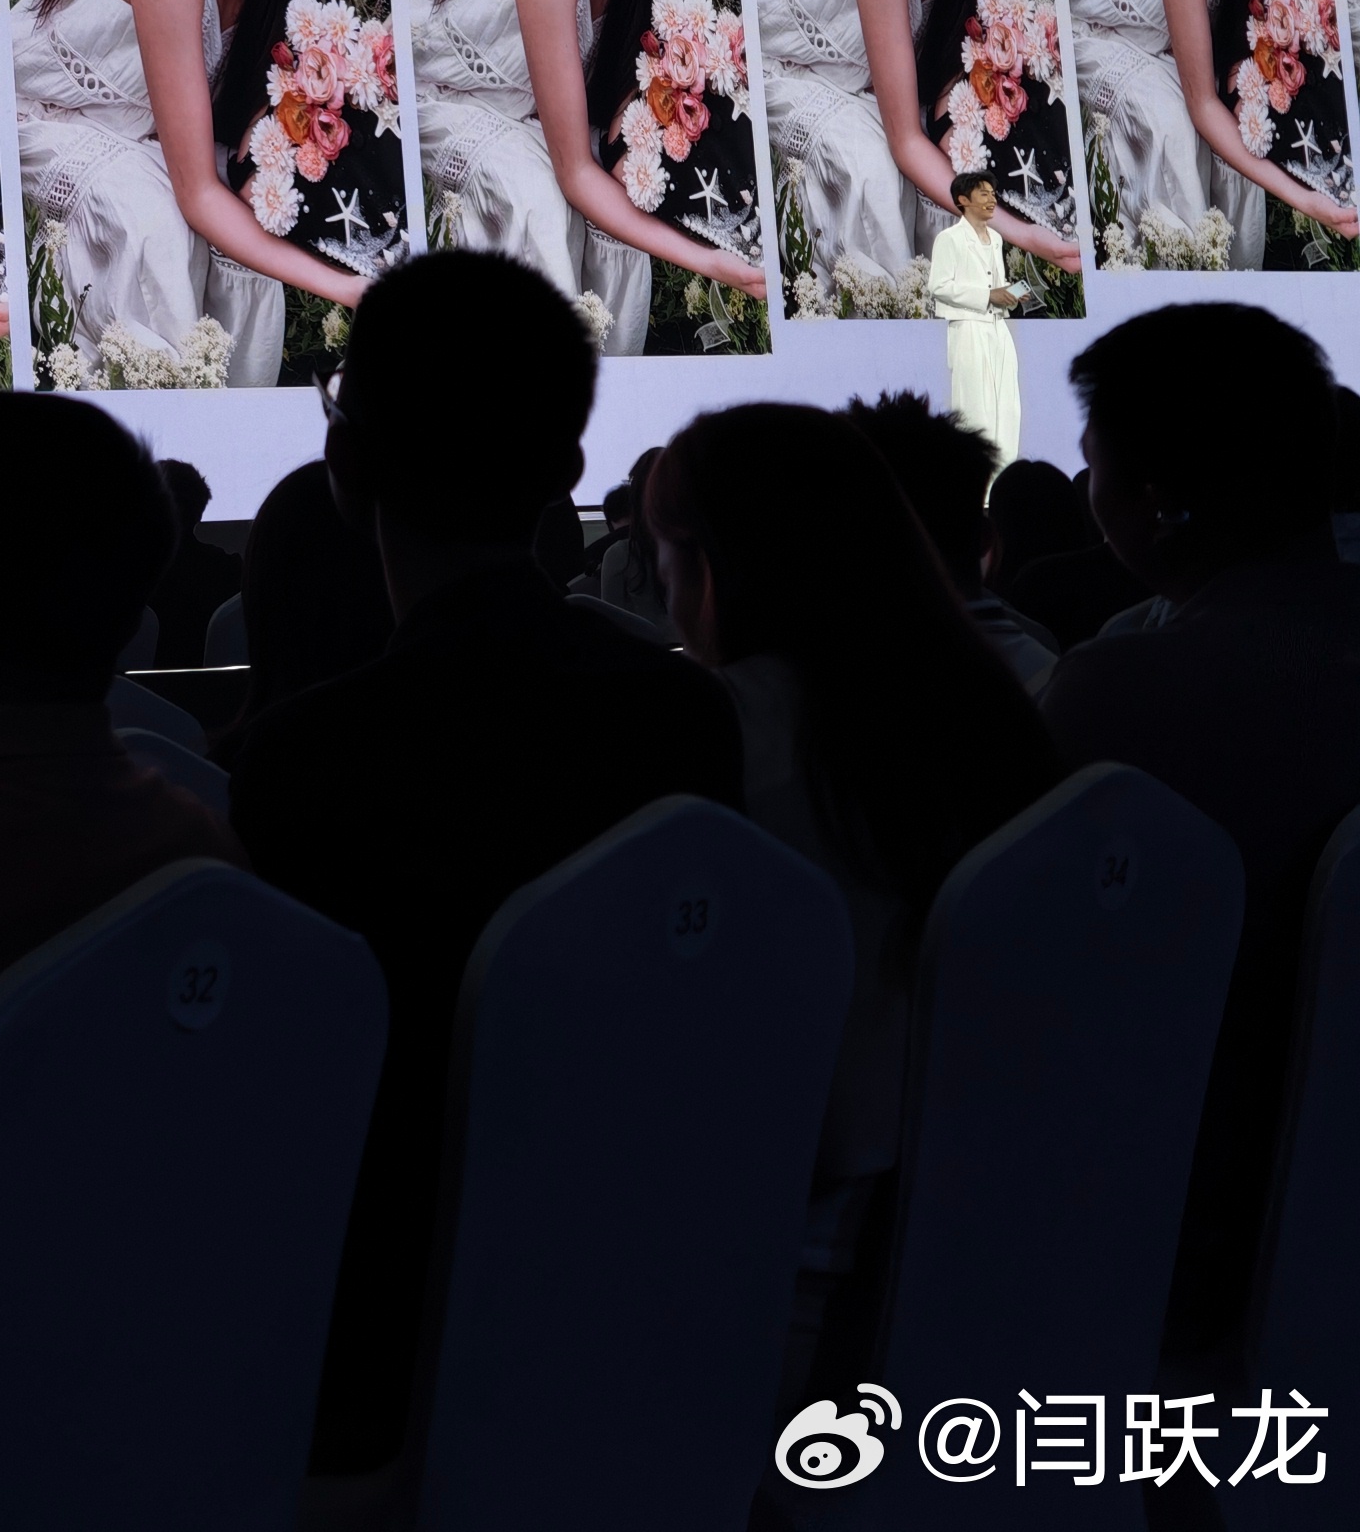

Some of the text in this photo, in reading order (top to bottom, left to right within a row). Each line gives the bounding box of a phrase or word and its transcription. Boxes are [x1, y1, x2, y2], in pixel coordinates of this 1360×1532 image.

[1100, 855, 1130, 891] 34
[675, 898, 710, 937] 33
[178, 965, 219, 1005] 32
